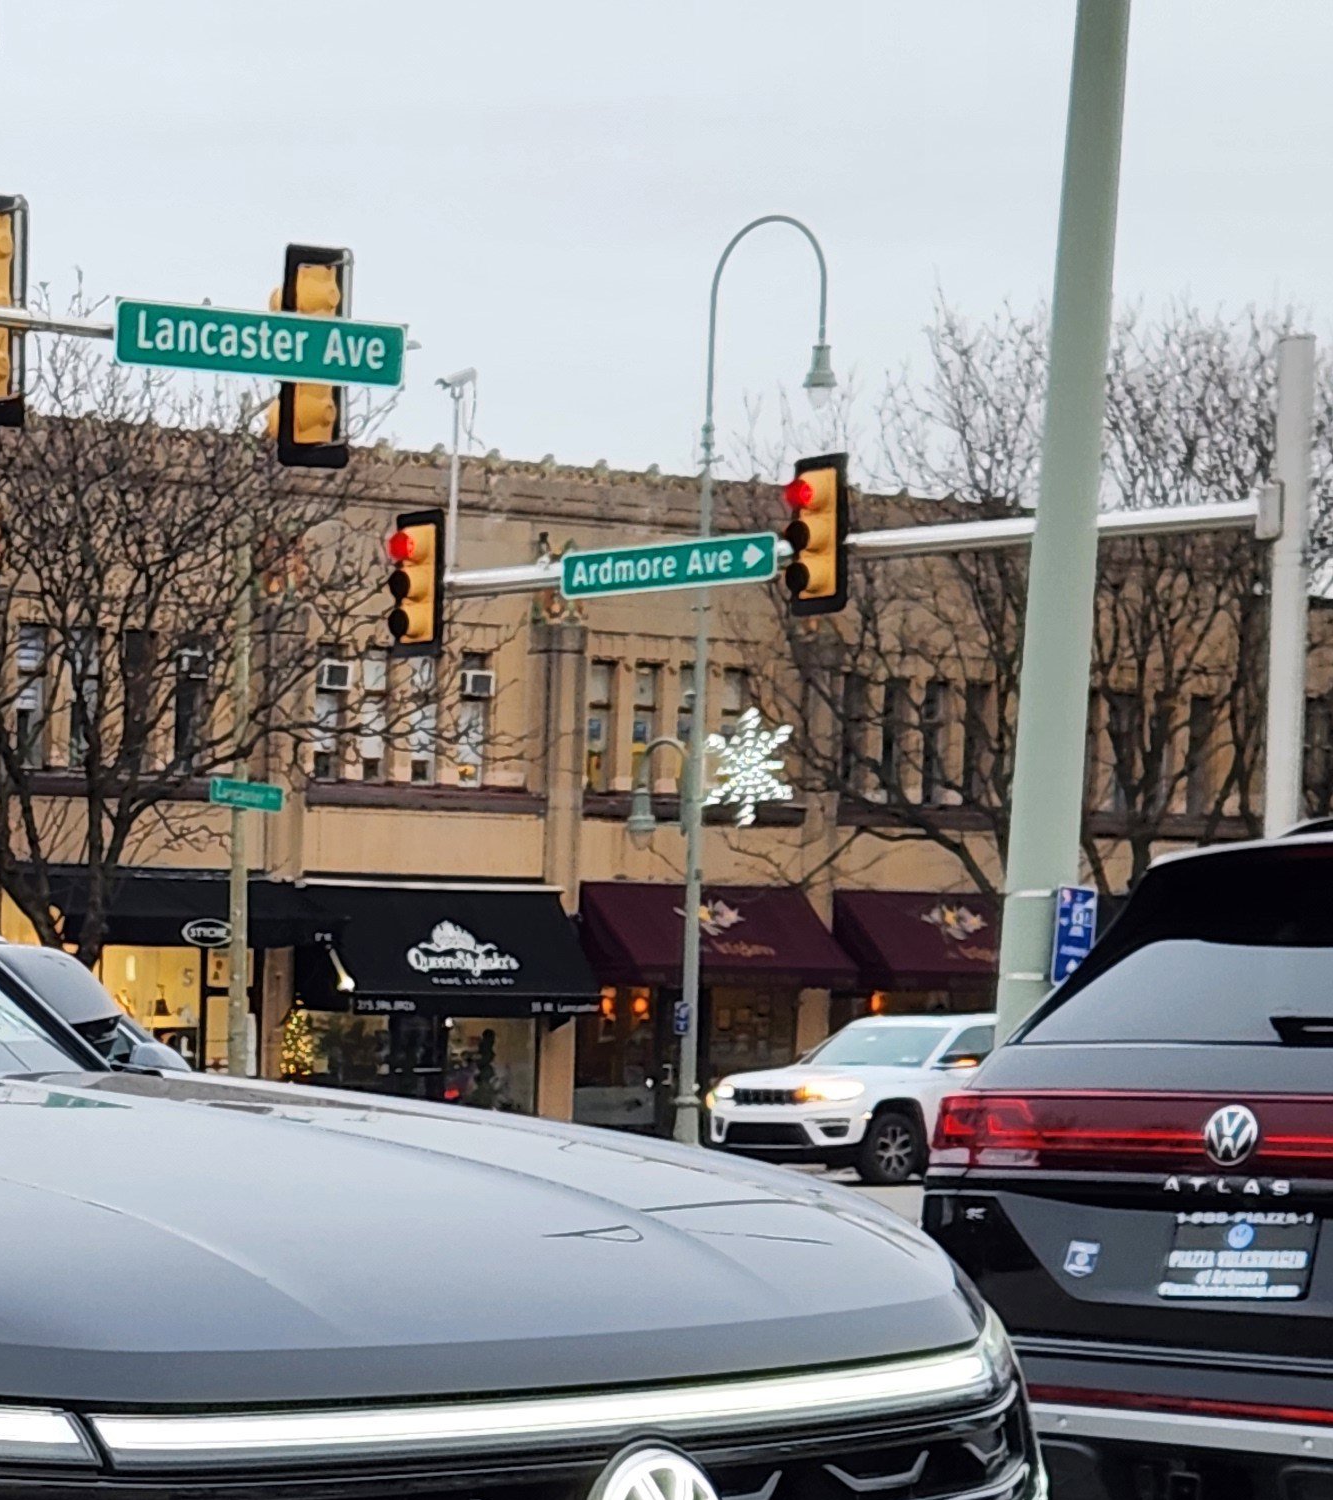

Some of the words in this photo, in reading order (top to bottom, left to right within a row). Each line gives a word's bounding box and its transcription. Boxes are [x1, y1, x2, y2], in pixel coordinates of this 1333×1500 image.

[137, 310, 309, 363] Lancaster
[323, 328, 386, 369] Ave
[572, 556, 677, 587] Ardmore
[686, 549, 734, 576] Ave
[1163, 1175, 1291, 1196] ATLAS
